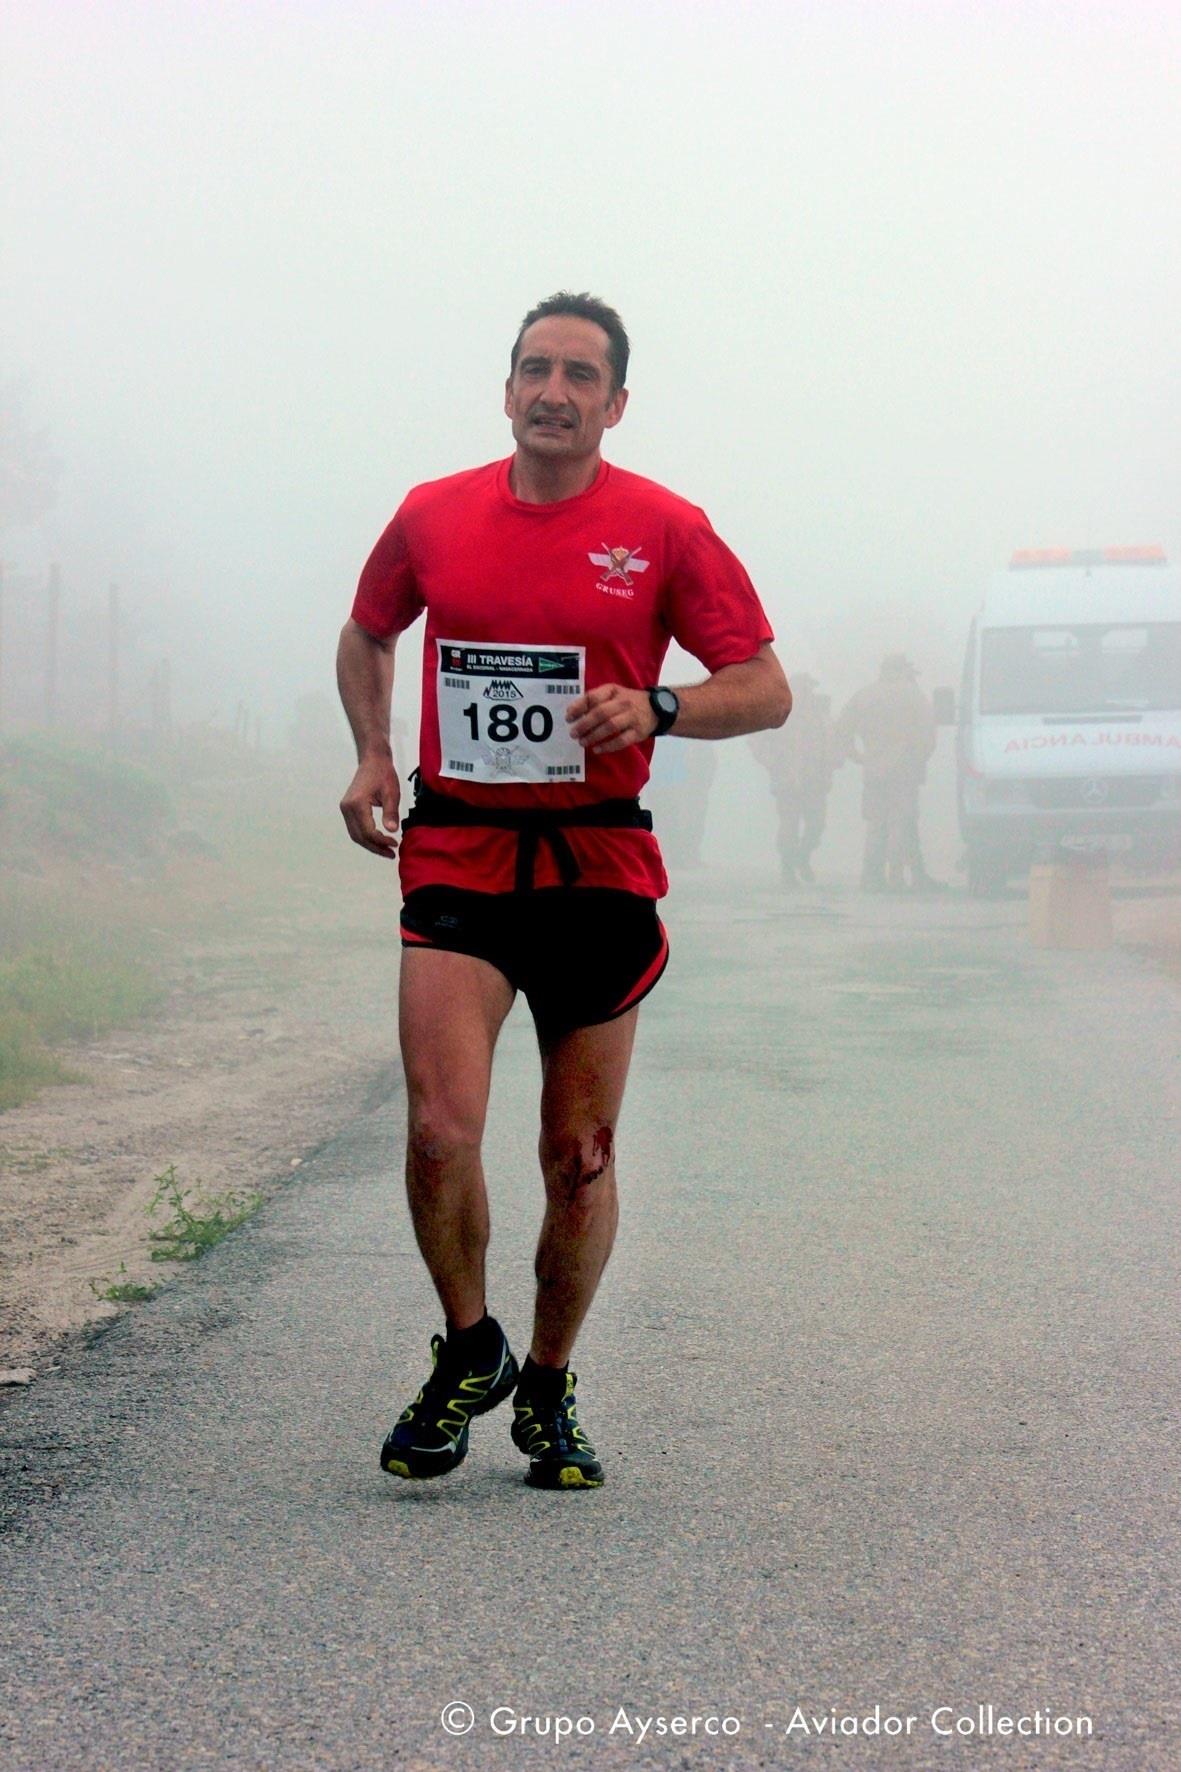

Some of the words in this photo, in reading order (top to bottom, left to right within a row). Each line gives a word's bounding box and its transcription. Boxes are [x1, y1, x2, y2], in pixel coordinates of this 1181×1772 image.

[479, 655, 533, 666] TRAVESÍA
[493, 690, 517, 698] 2015
[463, 702, 554, 742] 180
